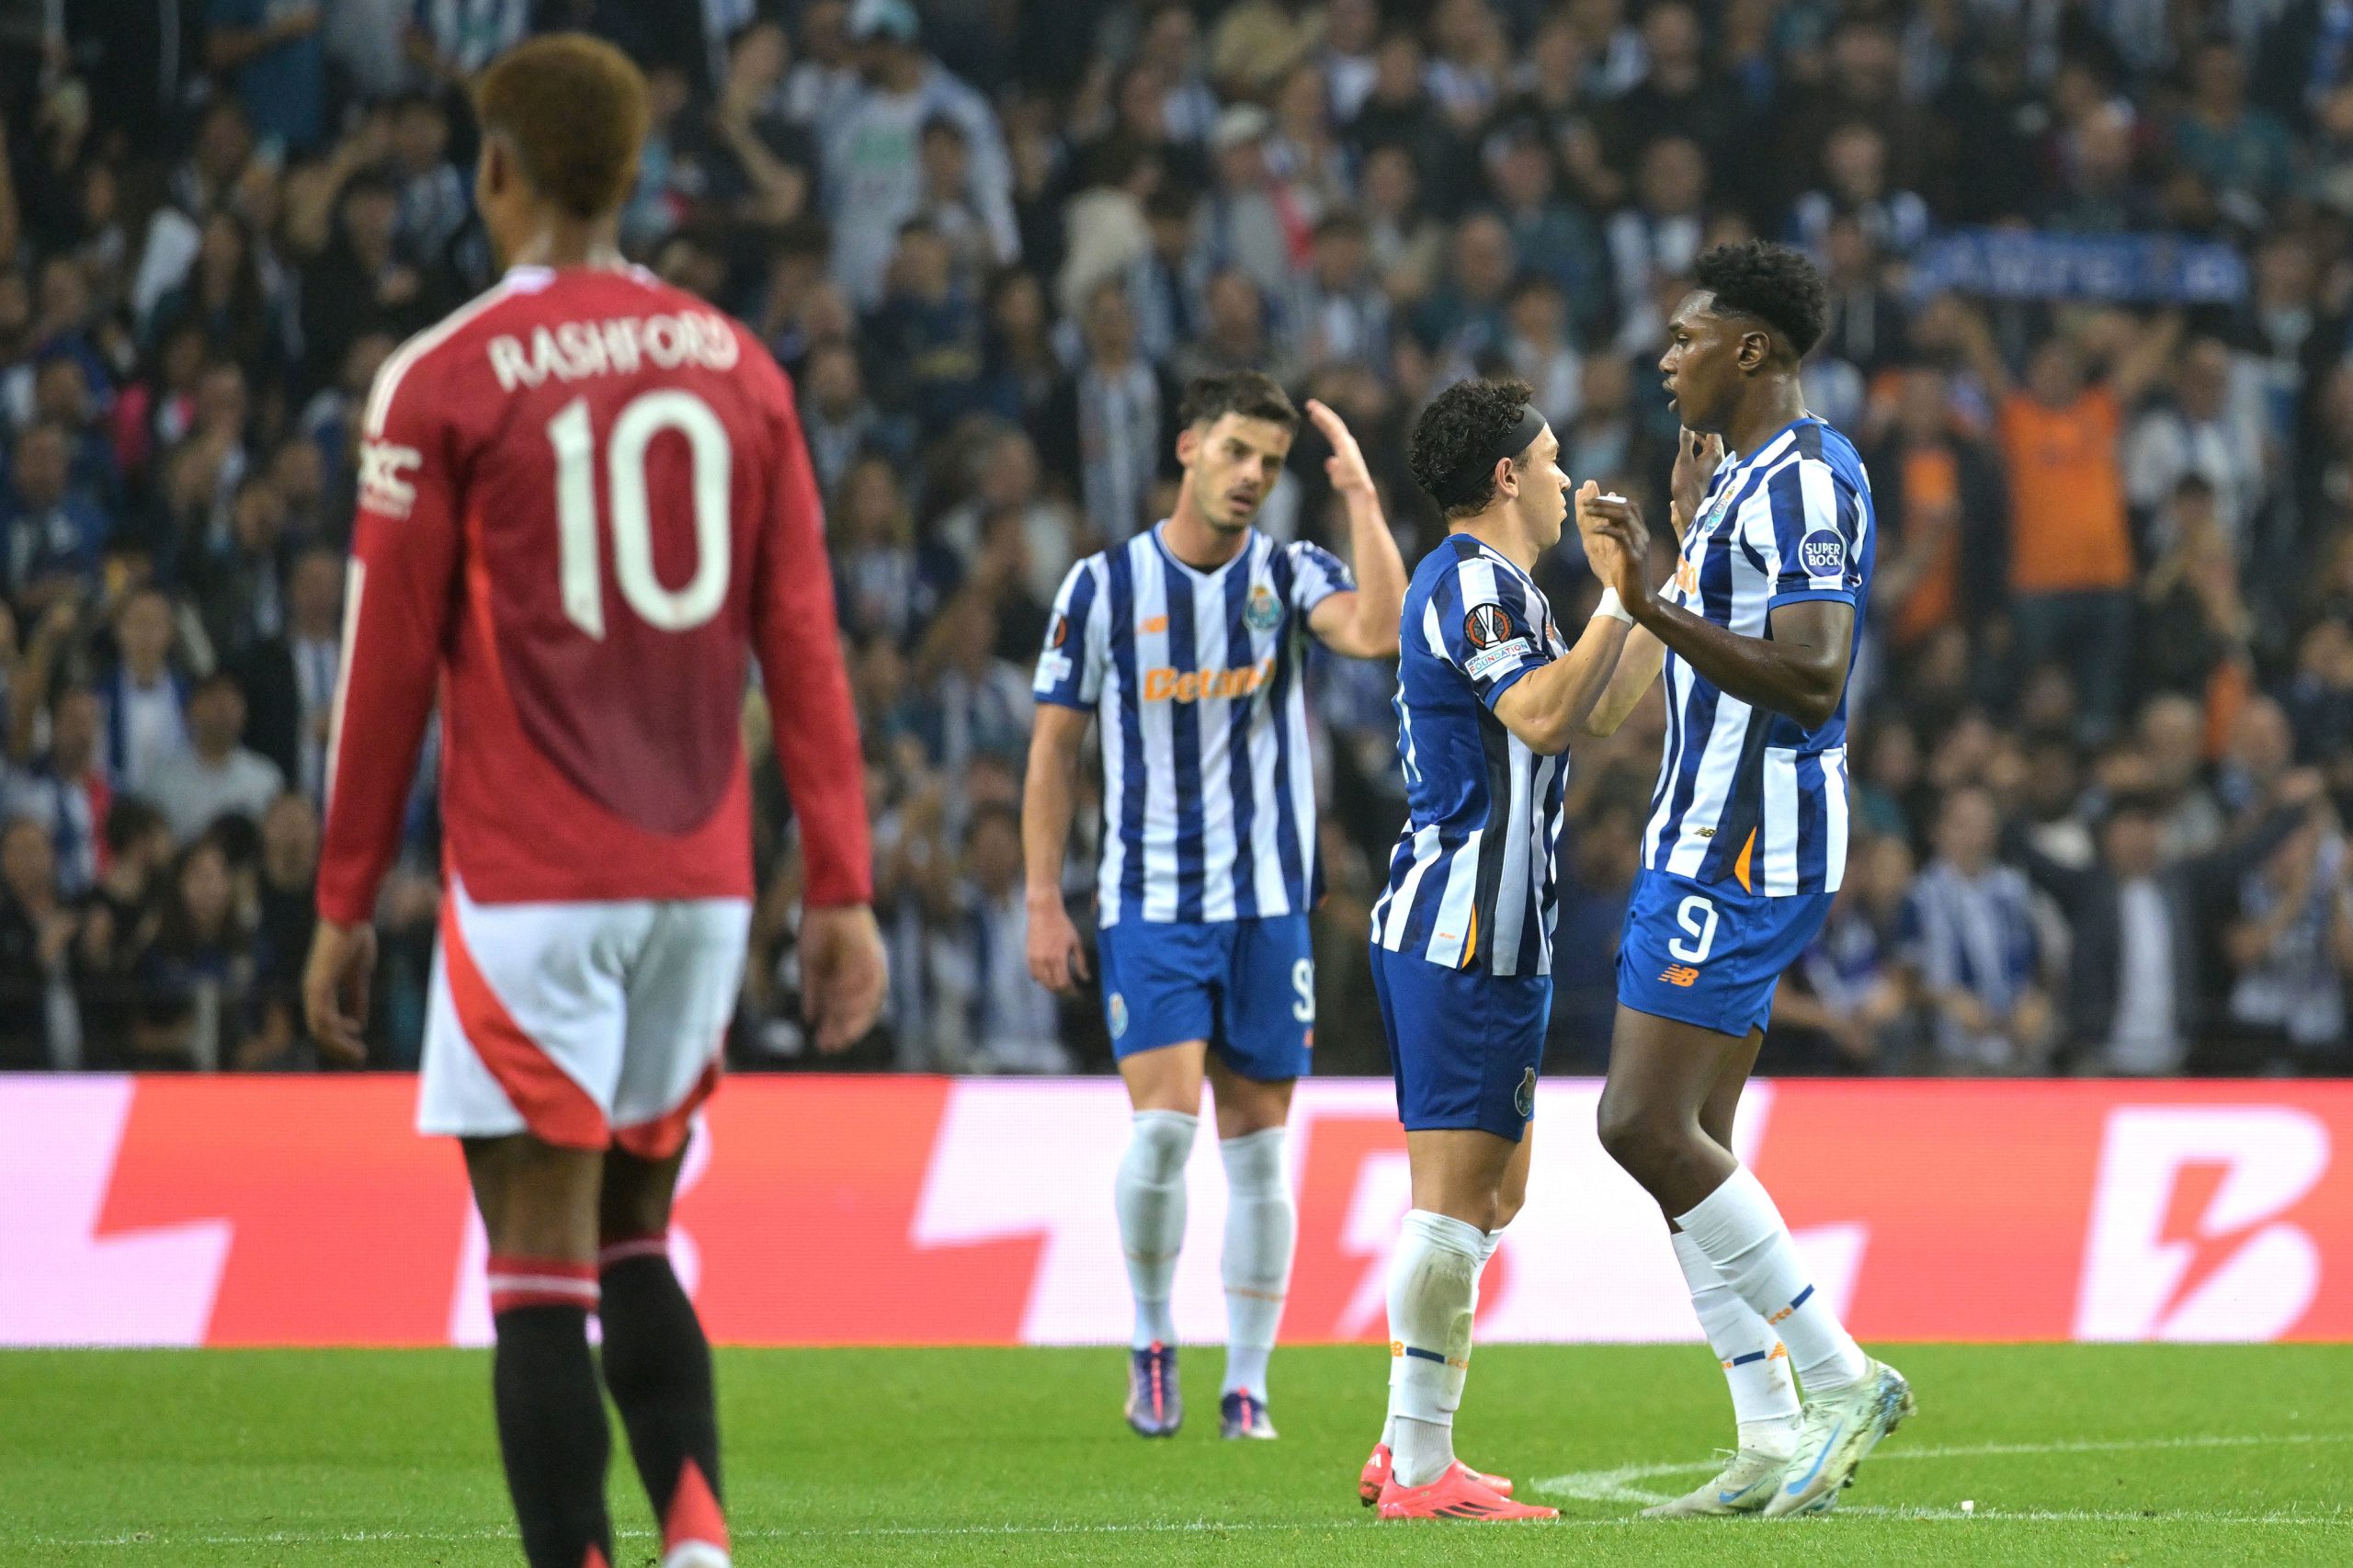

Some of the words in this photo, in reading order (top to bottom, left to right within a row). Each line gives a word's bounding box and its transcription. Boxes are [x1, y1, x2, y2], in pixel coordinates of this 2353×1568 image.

[488, 310, 739, 392] RASHFORD
[547, 390, 732, 642] 10
[1805, 542, 1841, 555] SUPER
[1808, 554, 1842, 566] BOCK
[1470, 643, 1529, 674] FOUNDATION
[1668, 895, 1720, 963] 9
